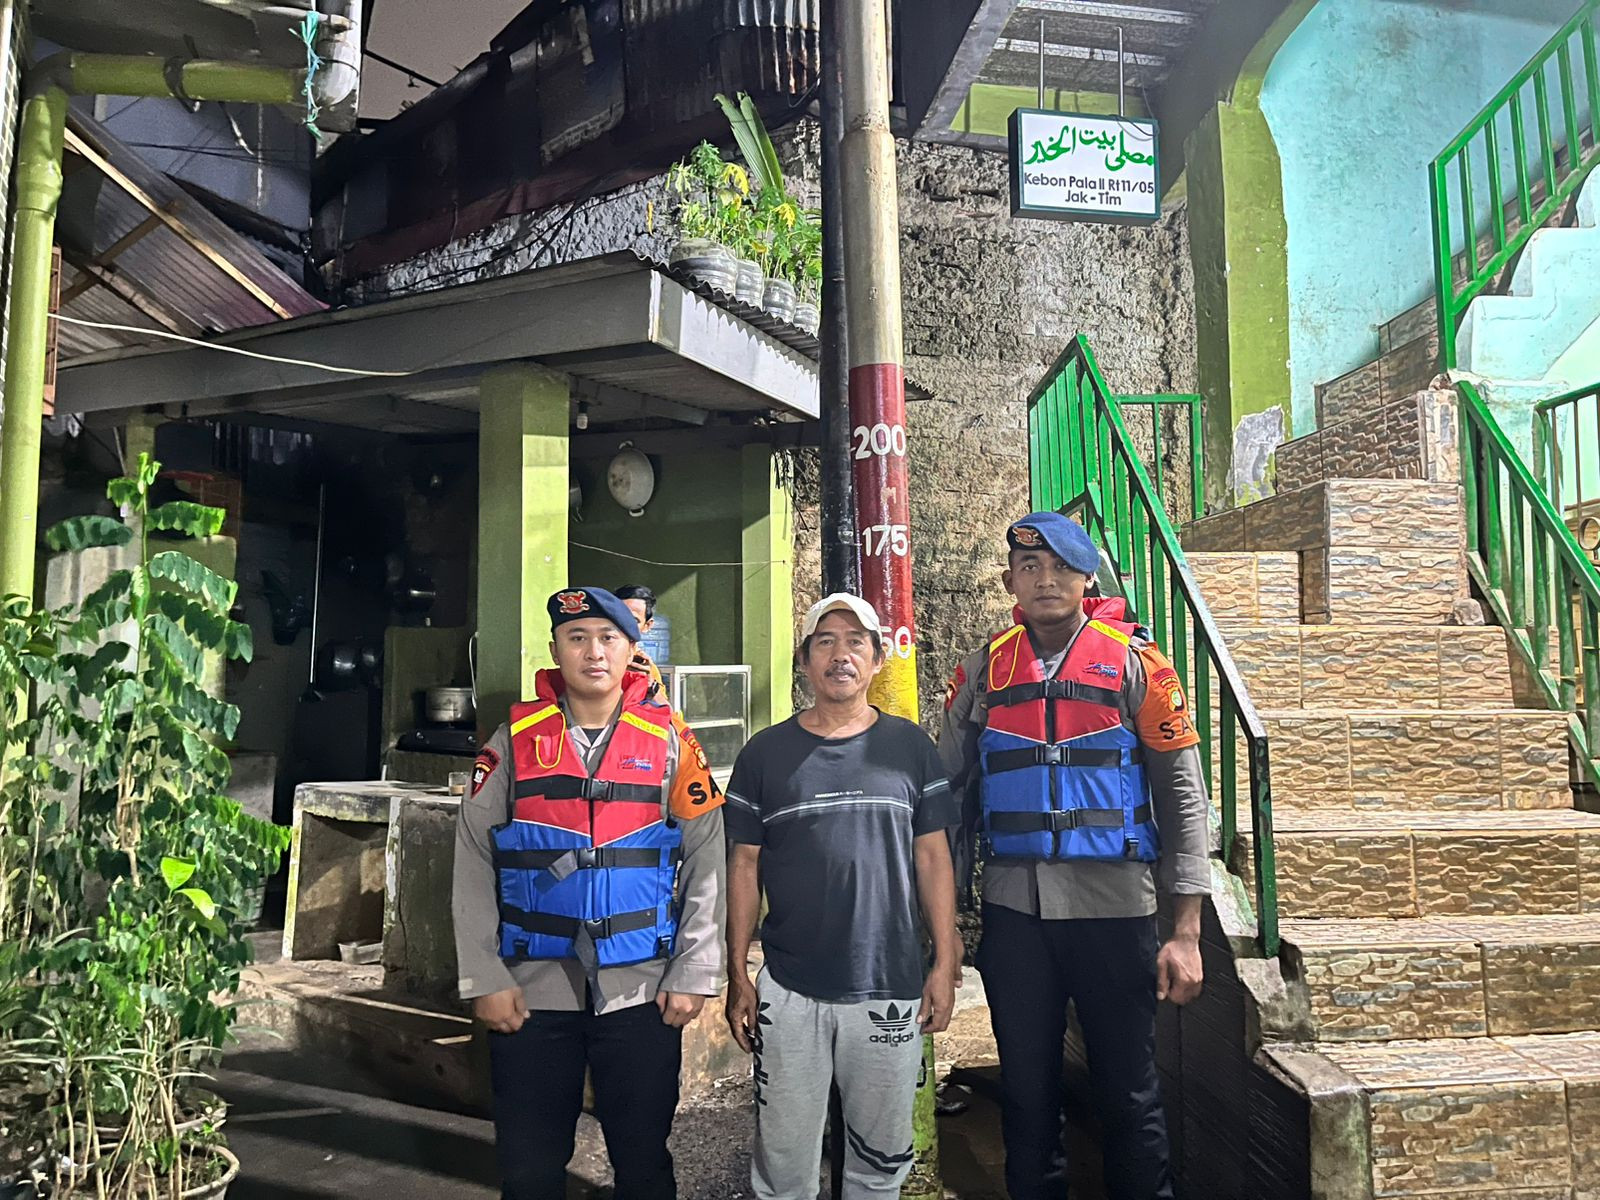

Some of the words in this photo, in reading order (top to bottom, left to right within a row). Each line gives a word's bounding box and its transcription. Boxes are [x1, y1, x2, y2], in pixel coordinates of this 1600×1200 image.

[1024, 125, 1076, 165] الخير
[1079, 129, 1116, 151] بيت
[1024, 172, 1067, 187] Kebon
[1069, 176, 1096, 190] Pala
[1065, 190, 1088, 204] Jak
[1098, 191, 1122, 206] Tim
[853, 423, 907, 460] 200
[862, 524, 909, 556] 175
[880, 625, 912, 659] 50
[869, 1031, 914, 1043] adidas
